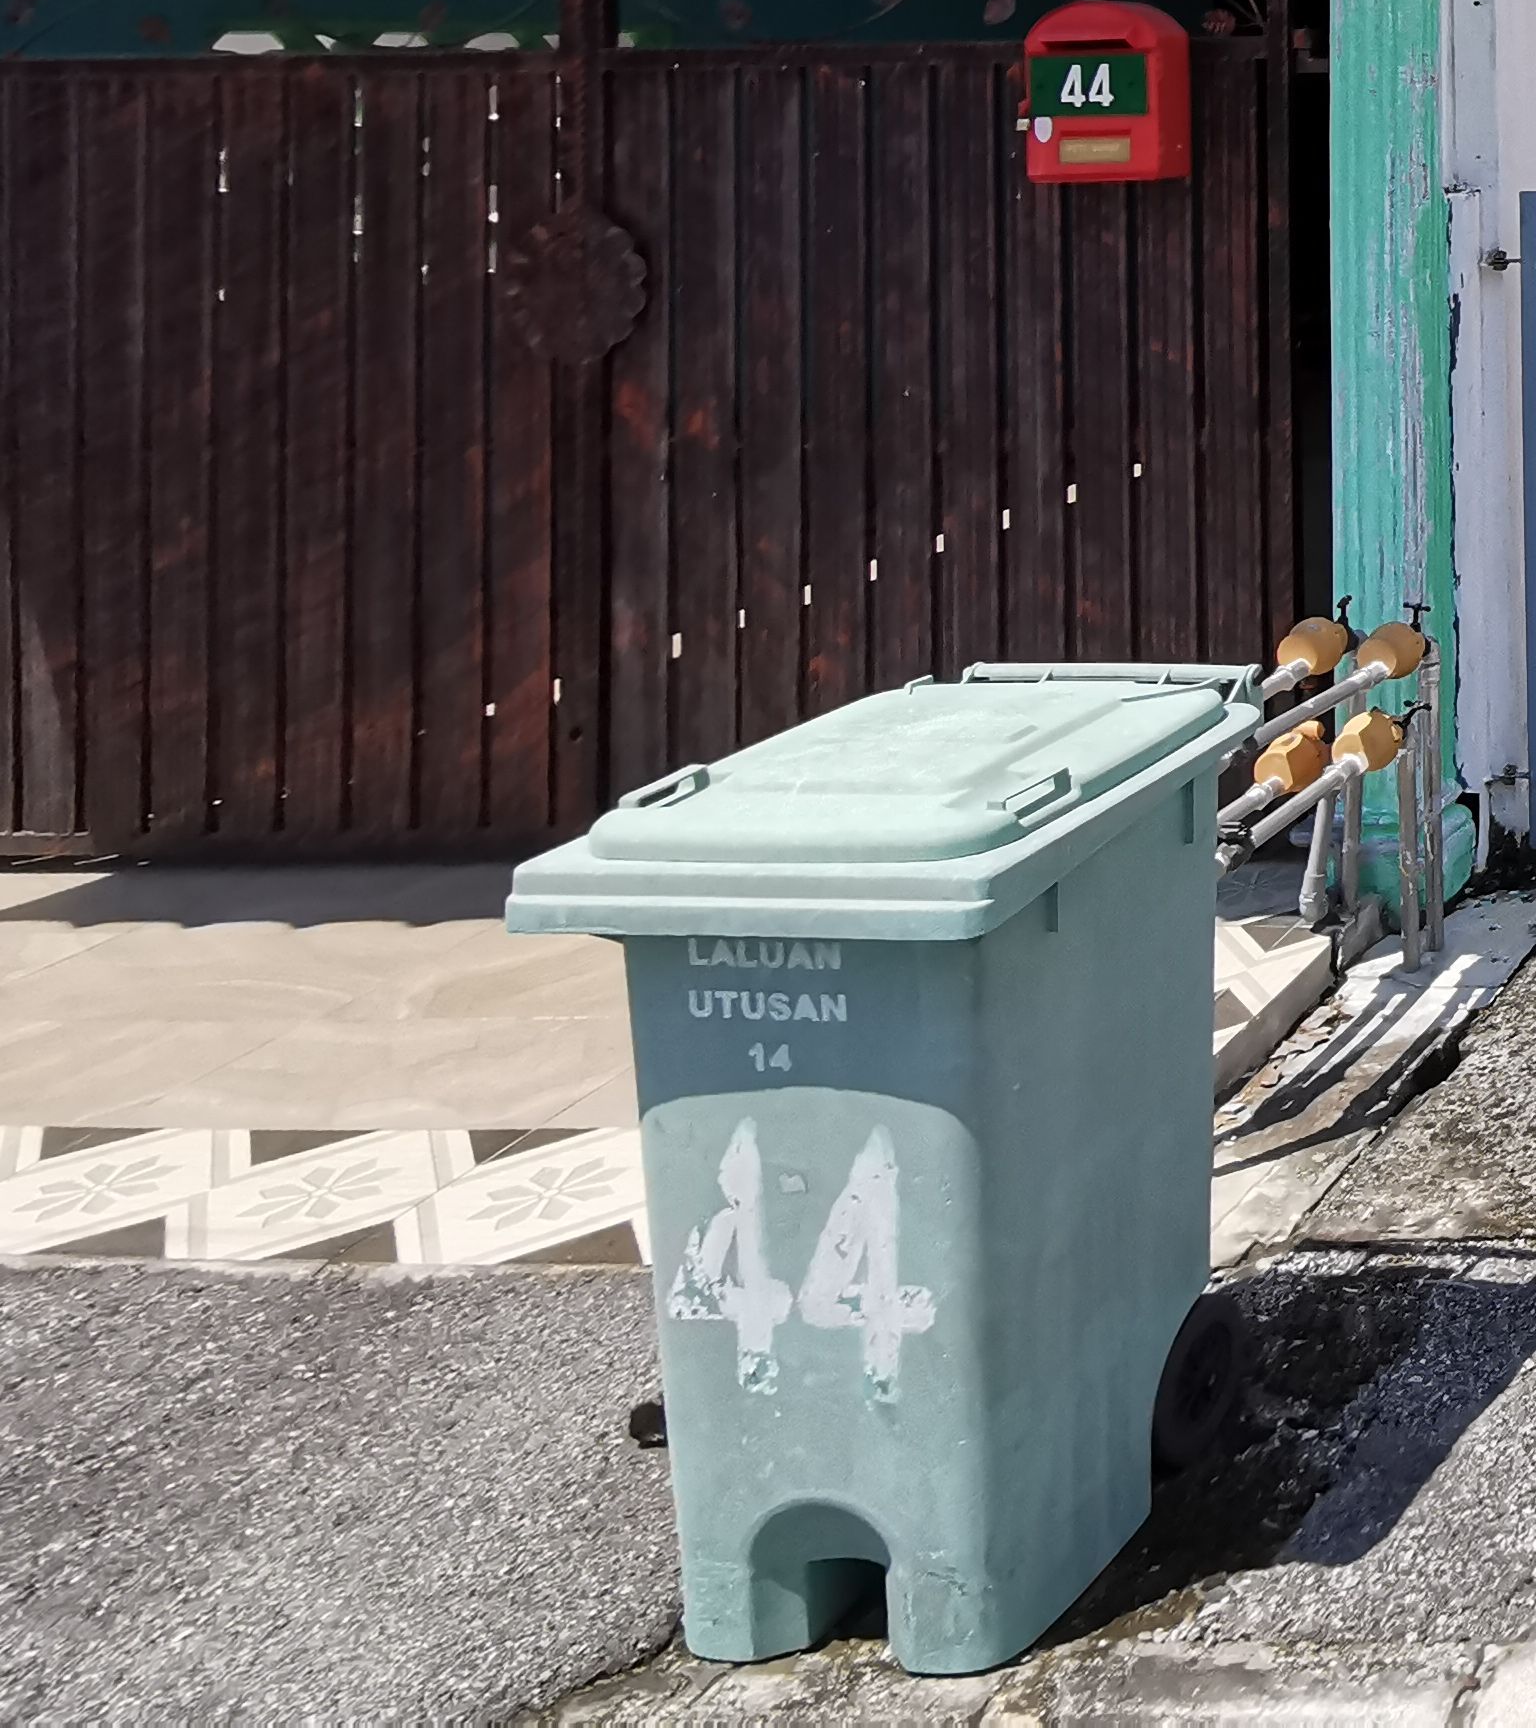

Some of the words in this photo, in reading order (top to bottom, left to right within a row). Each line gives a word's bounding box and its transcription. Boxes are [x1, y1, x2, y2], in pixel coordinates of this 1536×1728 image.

[1060, 63, 1114, 107] 44
[688, 938, 841, 970] LALUAN
[688, 990, 847, 1022] UTUSAN
[748, 1042, 792, 1072] 14
[667, 1116, 937, 1404] 44
